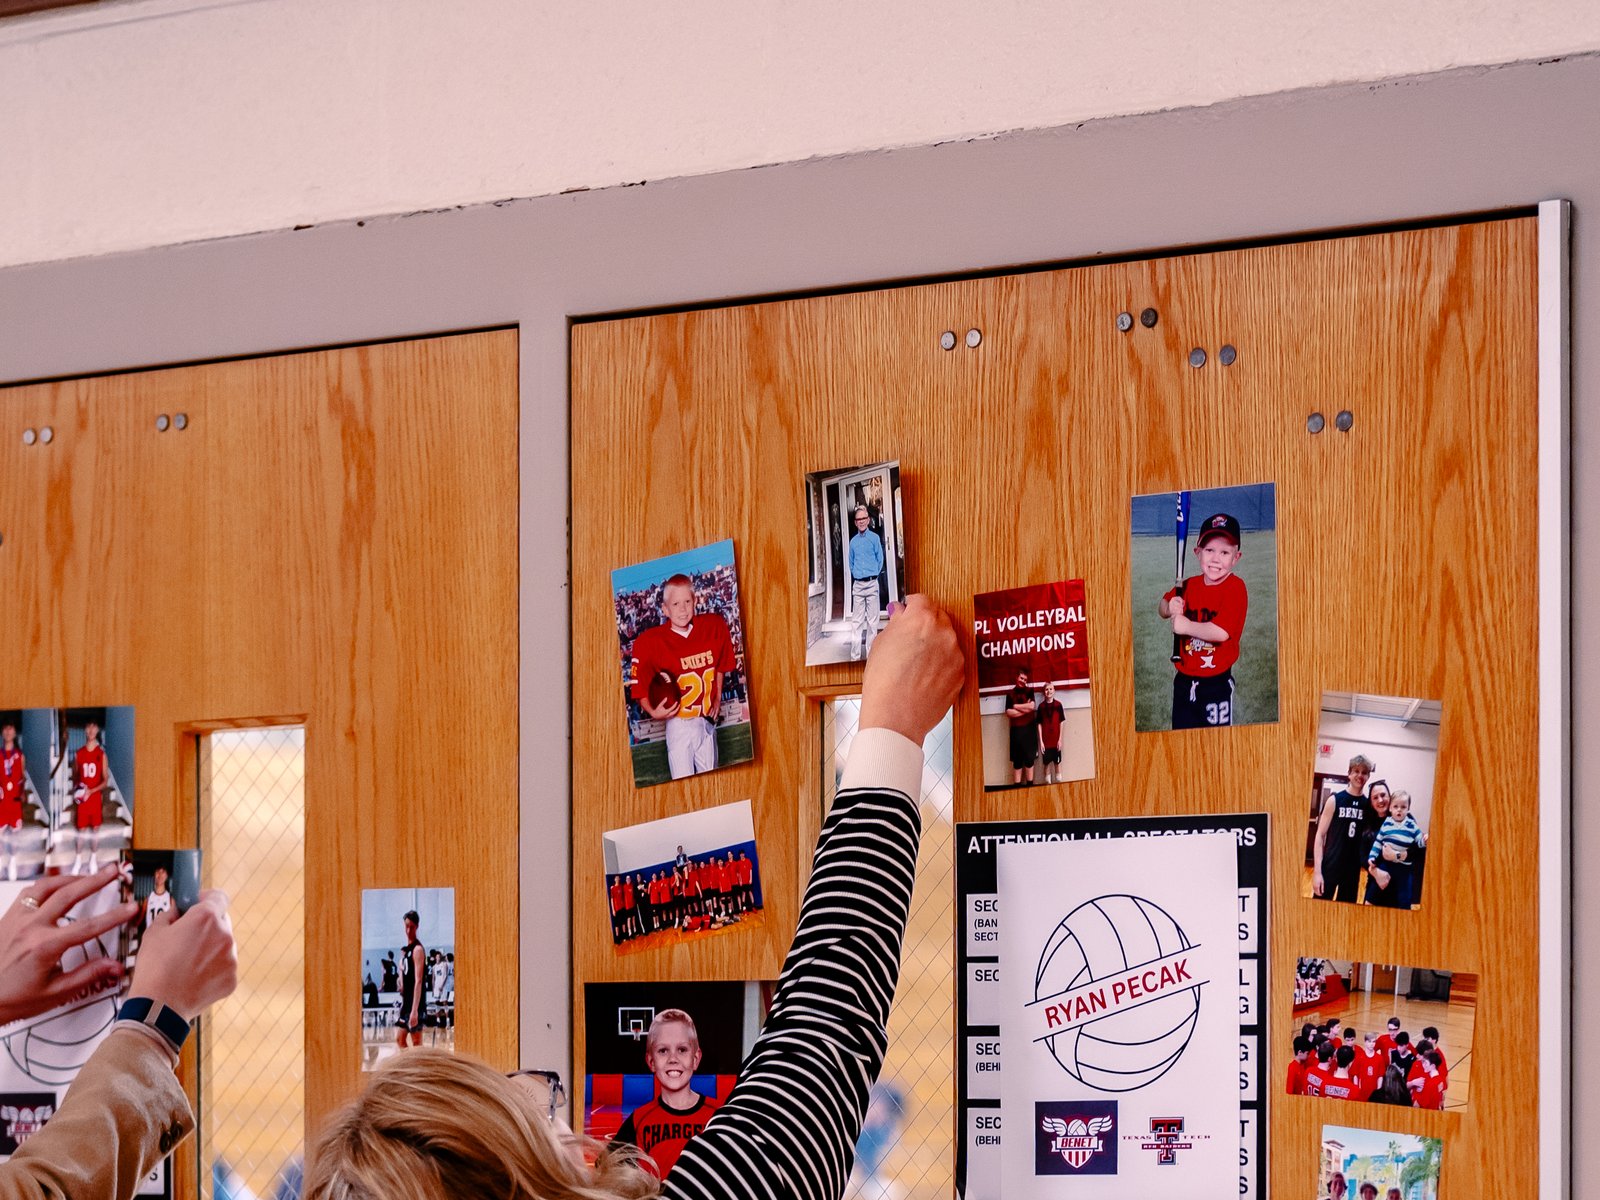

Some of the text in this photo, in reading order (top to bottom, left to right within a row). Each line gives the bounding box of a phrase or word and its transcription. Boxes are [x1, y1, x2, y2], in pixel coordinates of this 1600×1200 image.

[997, 605, 1086, 632] VOLLEYBAL
[981, 632, 1076, 658] CHAMPIONS
[680, 649, 714, 670] CHIEFS
[1205, 700, 1230, 725] 32
[83, 762, 97, 778] 10
[1348, 821, 1357, 838] 6
[1044, 958, 1193, 1029] RYAN PECAK
[1061, 1137, 1094, 1148] BENET
